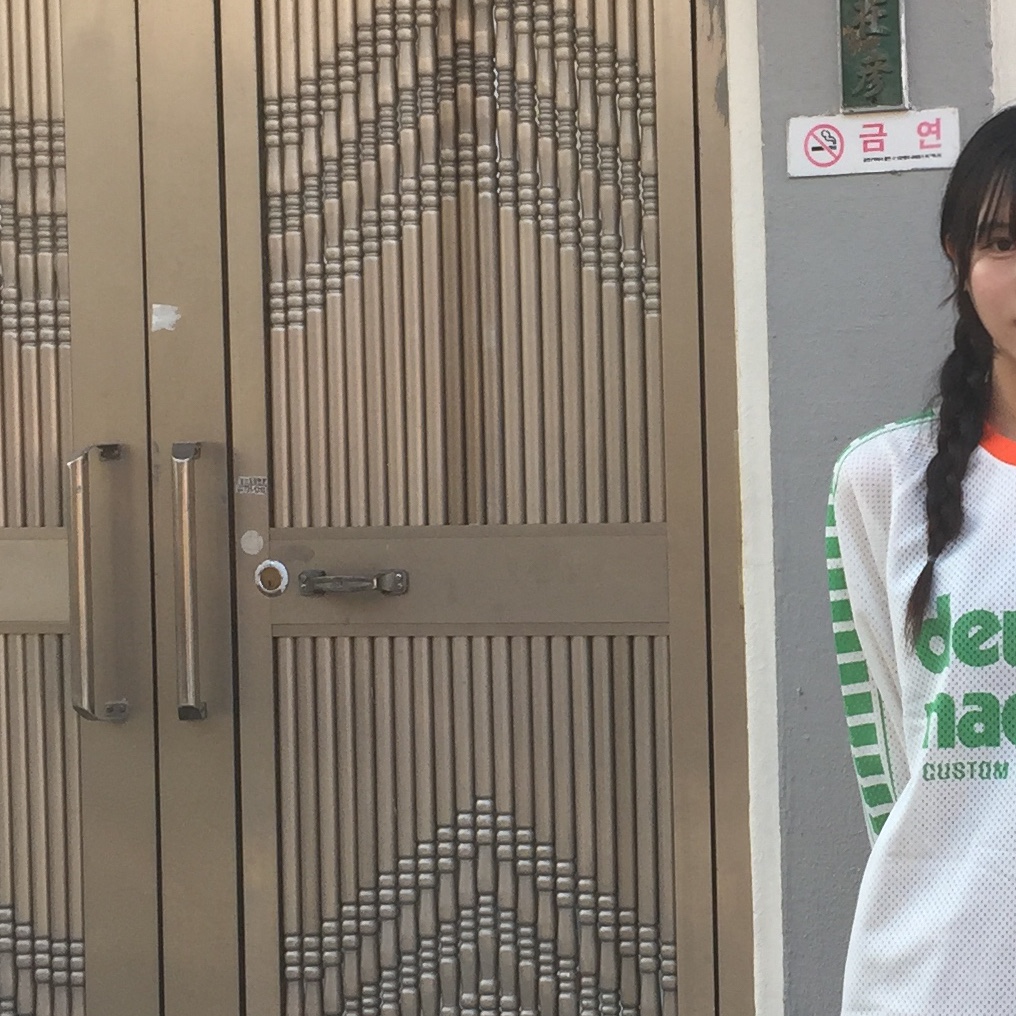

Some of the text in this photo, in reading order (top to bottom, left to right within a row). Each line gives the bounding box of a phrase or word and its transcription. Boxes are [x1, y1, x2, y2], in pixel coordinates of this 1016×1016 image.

[859, 117, 942, 153] 금 연
[922, 761, 1010, 782] CUSTOM
